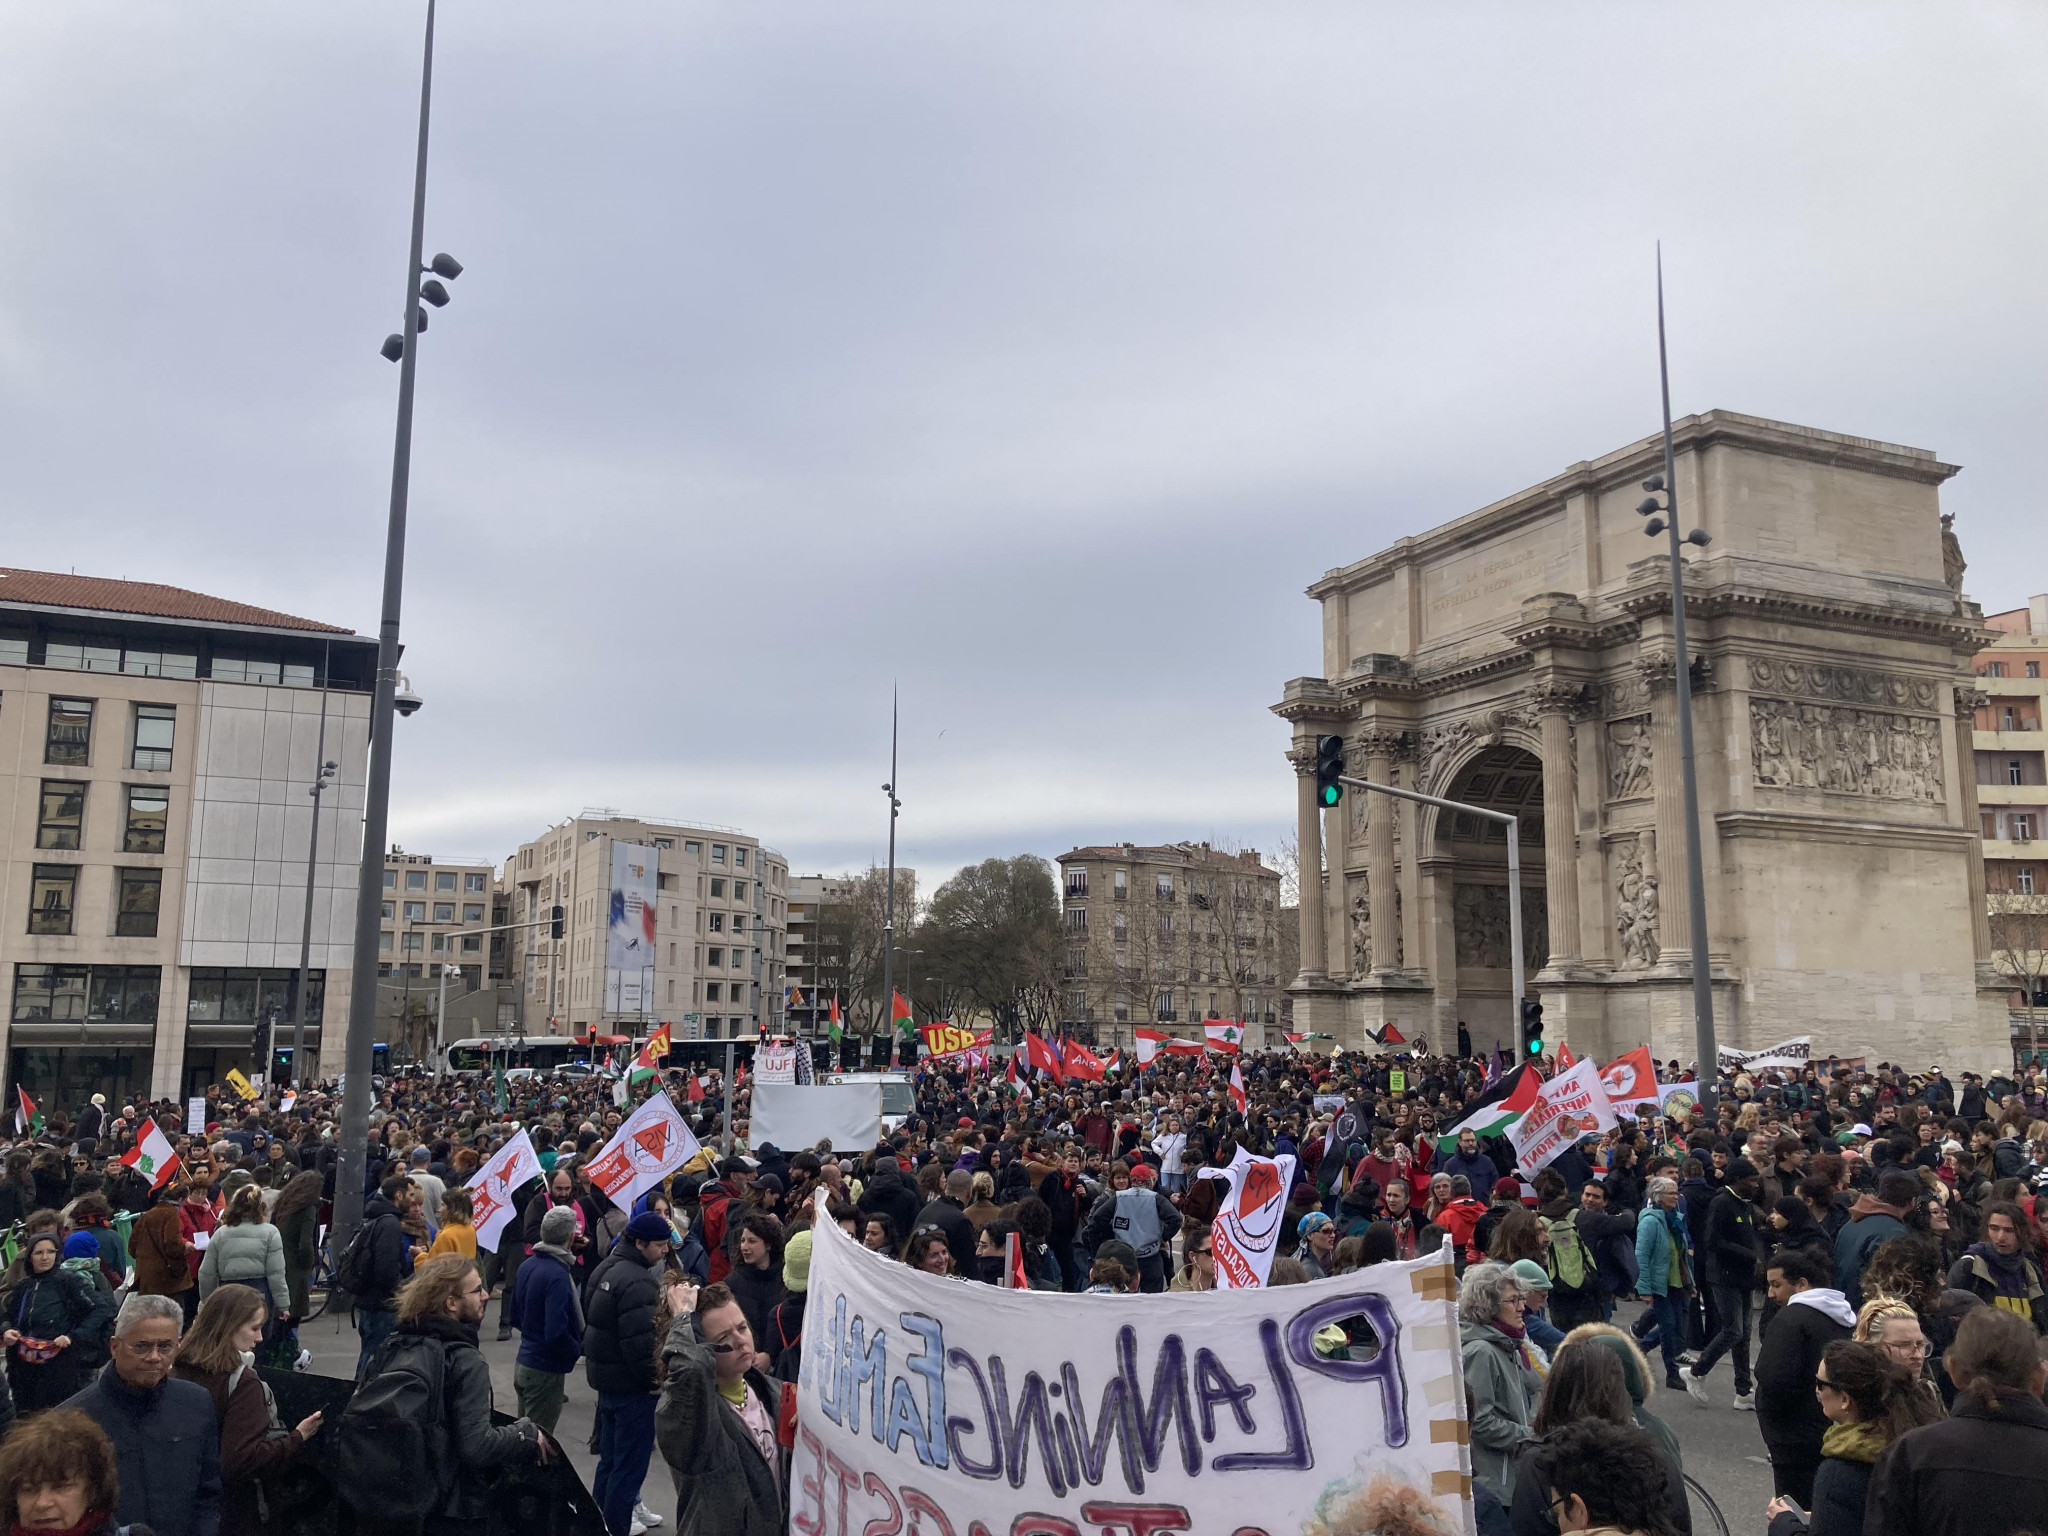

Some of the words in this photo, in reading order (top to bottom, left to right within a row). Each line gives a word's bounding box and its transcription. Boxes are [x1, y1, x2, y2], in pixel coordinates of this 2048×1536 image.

[1467, 572, 1478, 583] LA
[1484, 561, 1560, 595] RECONNAISSA
[1774, 1043, 1810, 1059] GUERR
